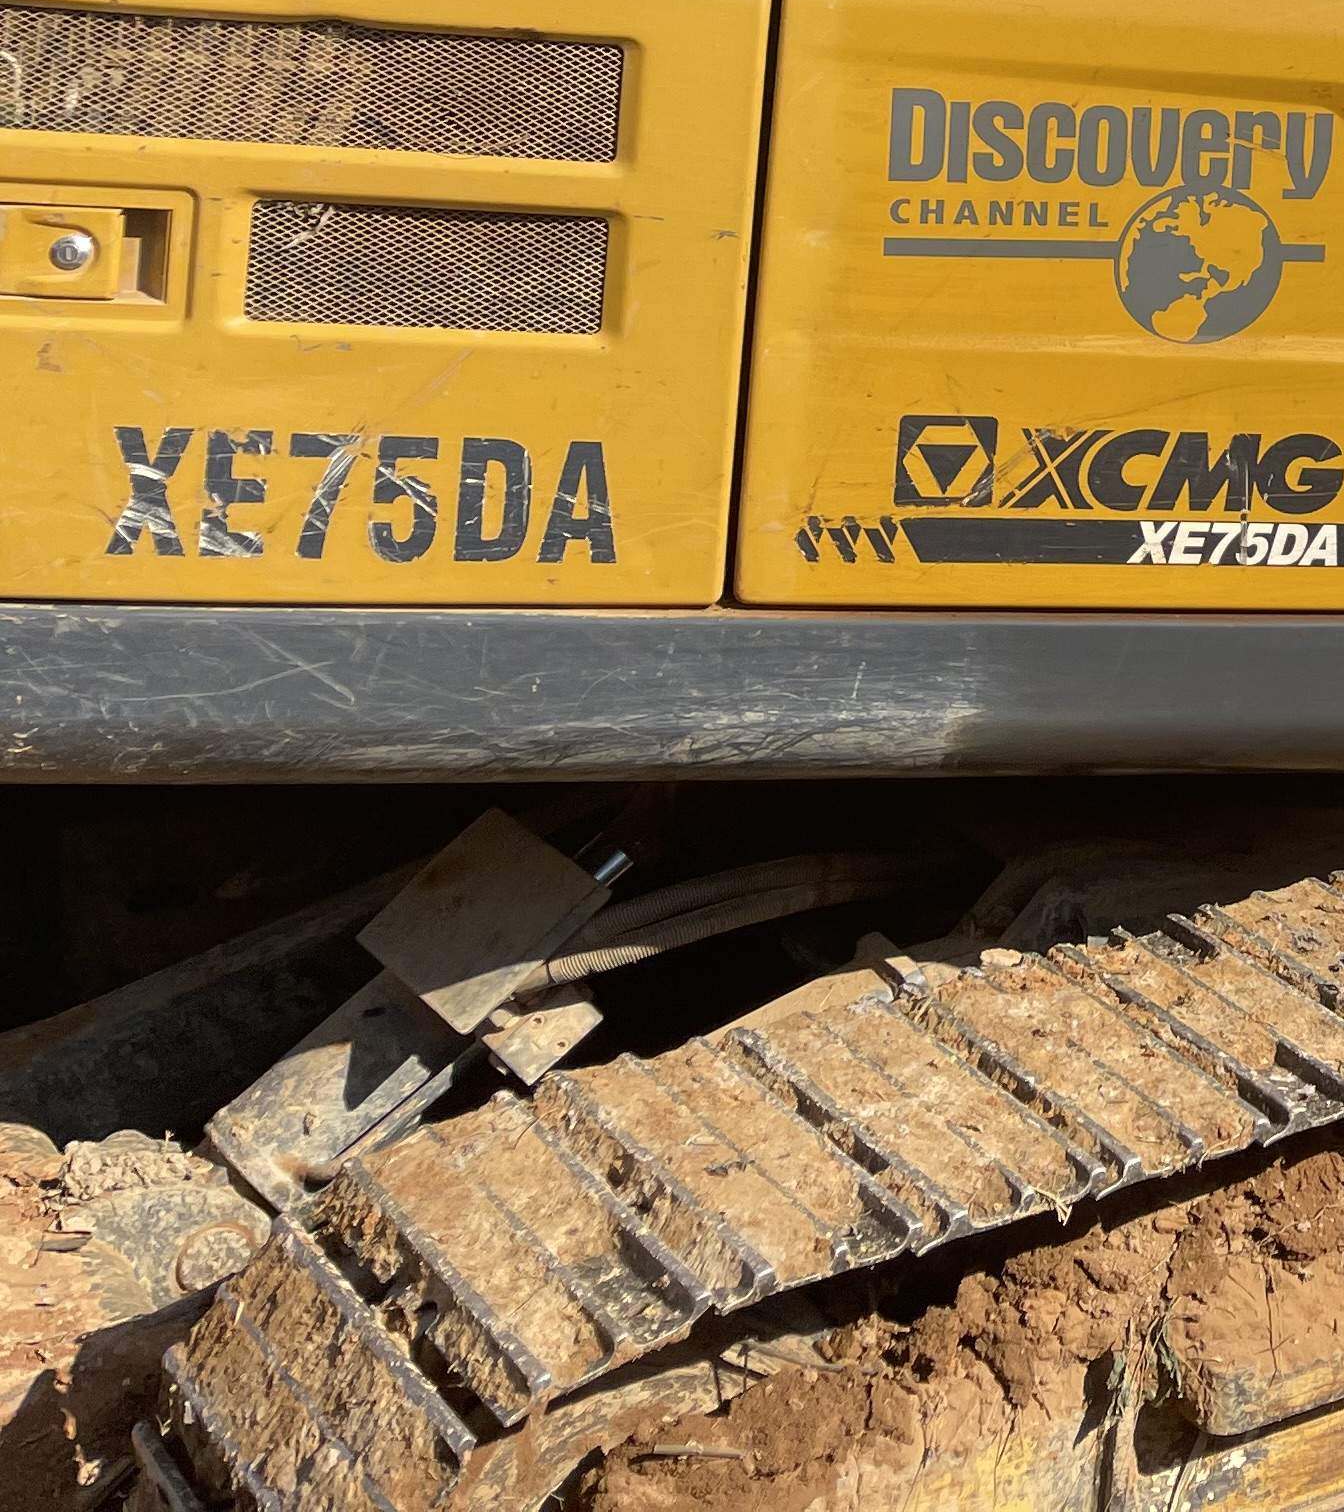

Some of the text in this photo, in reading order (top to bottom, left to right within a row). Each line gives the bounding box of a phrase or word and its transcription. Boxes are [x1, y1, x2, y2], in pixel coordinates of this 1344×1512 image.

[889, 198, 1110, 228] CHANNEL
[104, 426, 617, 564] XE75DA
[1127, 520, 1338, 567] XE75DA
